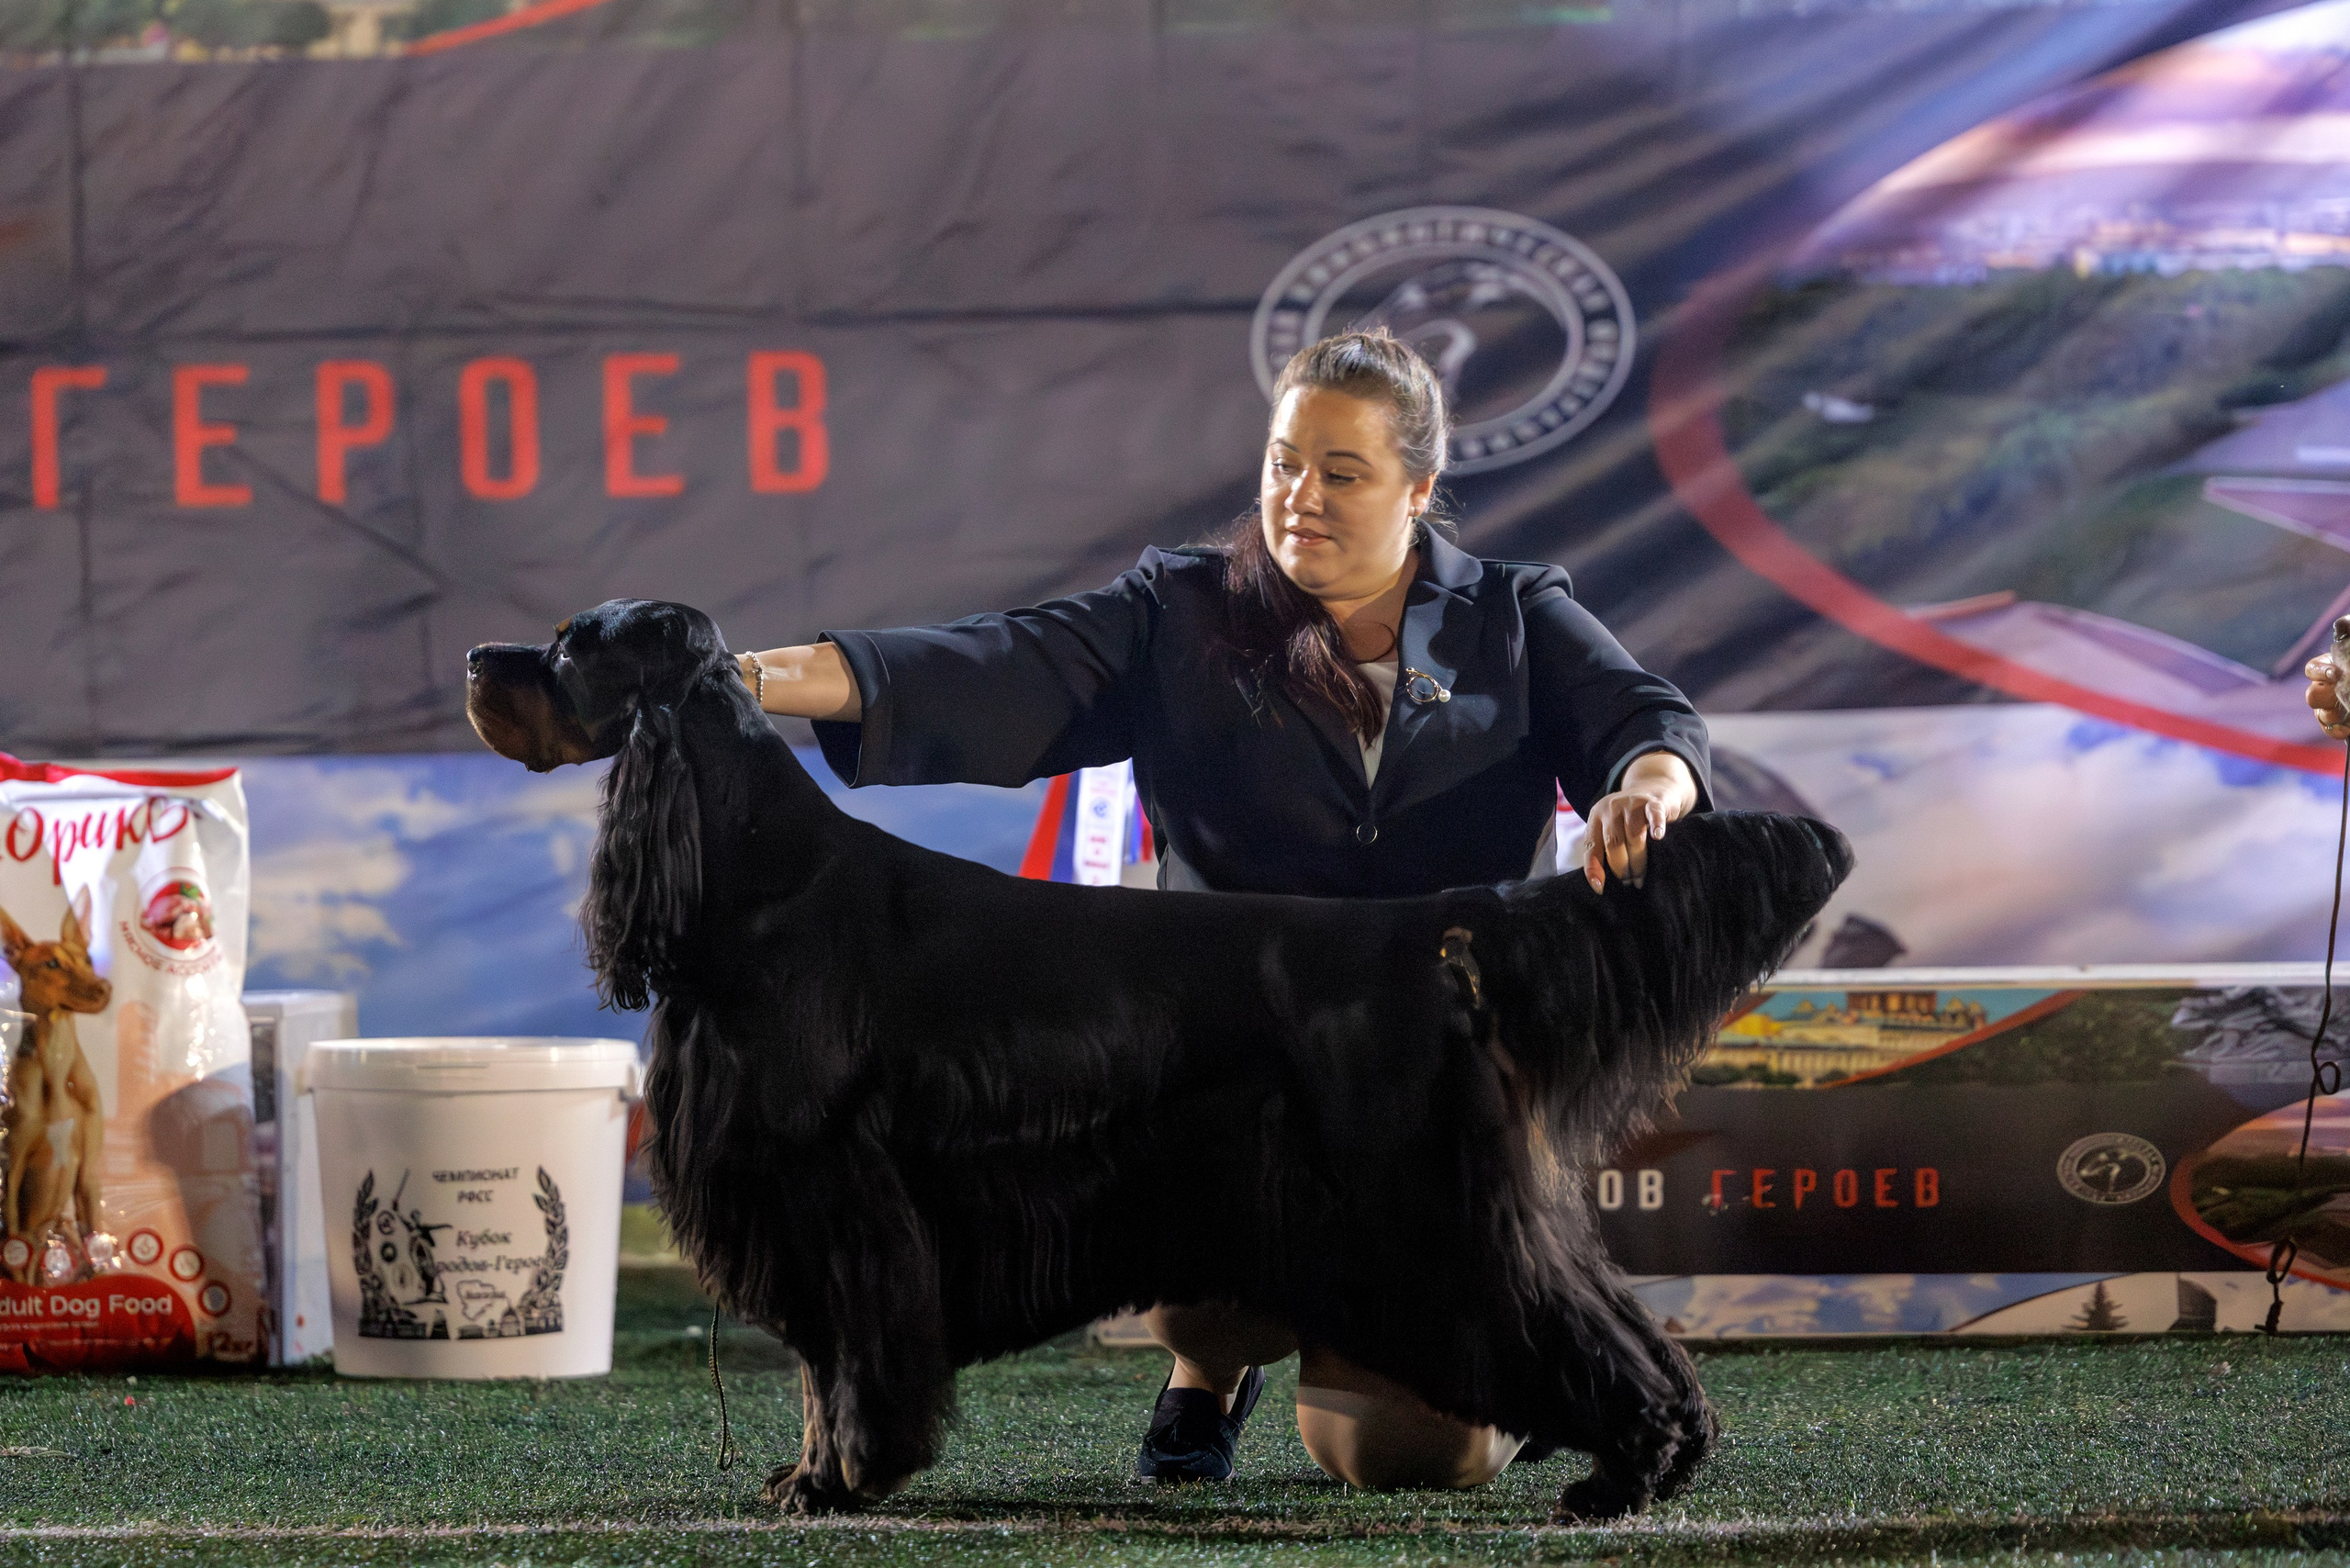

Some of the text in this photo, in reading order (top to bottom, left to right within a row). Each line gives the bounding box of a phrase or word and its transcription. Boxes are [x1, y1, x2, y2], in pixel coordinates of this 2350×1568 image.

[31, 350, 830, 509] ГЕРОЕВ
[431, 1166, 520, 1182] ЧЕМПИОНАТ
[1711, 1167, 1941, 1211] ГЕРОЕВ
[456, 1229, 512, 1250] Кубок
[50, 1294, 100, 1319] Dog
[108, 1294, 173, 1316] Food
